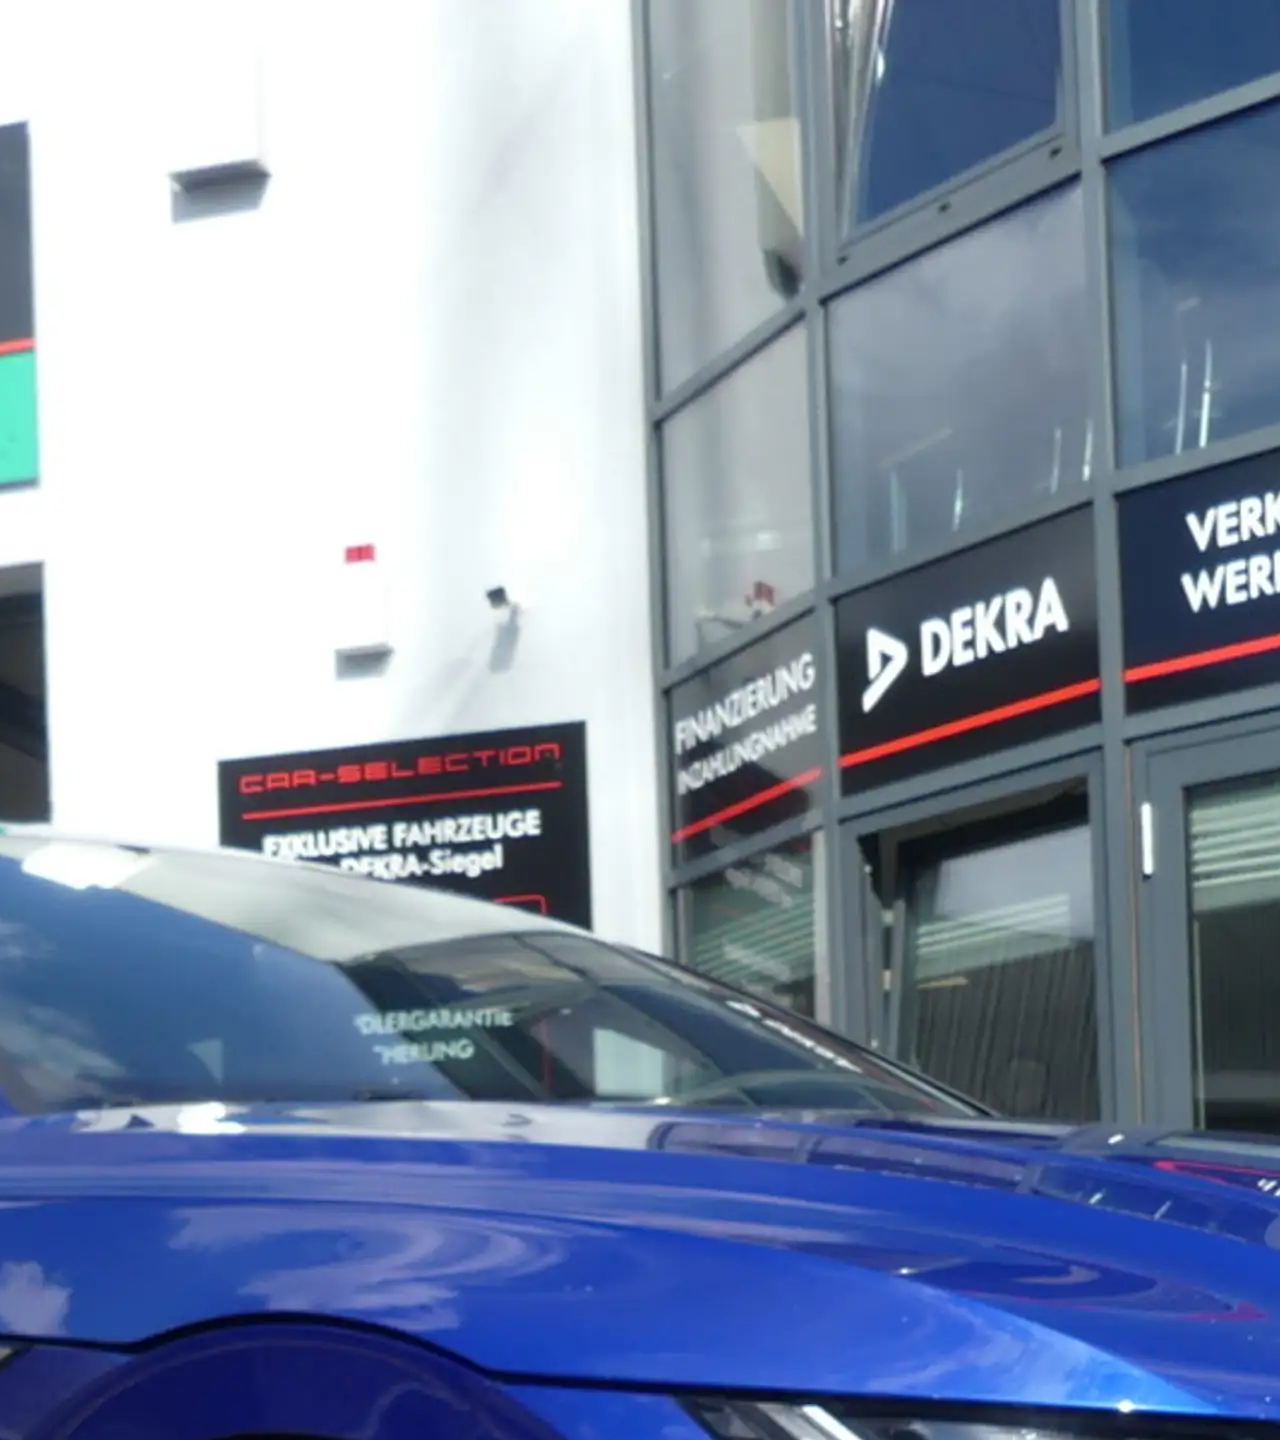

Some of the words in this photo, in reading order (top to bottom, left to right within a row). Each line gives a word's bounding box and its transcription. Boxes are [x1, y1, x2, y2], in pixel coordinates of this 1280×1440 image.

[920, 576, 1070, 677] DEKRA
[674, 651, 817, 755] FINANZIERUNG
[239, 742, 561, 794] CAR-SELECTION
[262, 824, 388, 861] EXKLUSIVE
[392, 808, 541, 848] FAHRZEUGE
